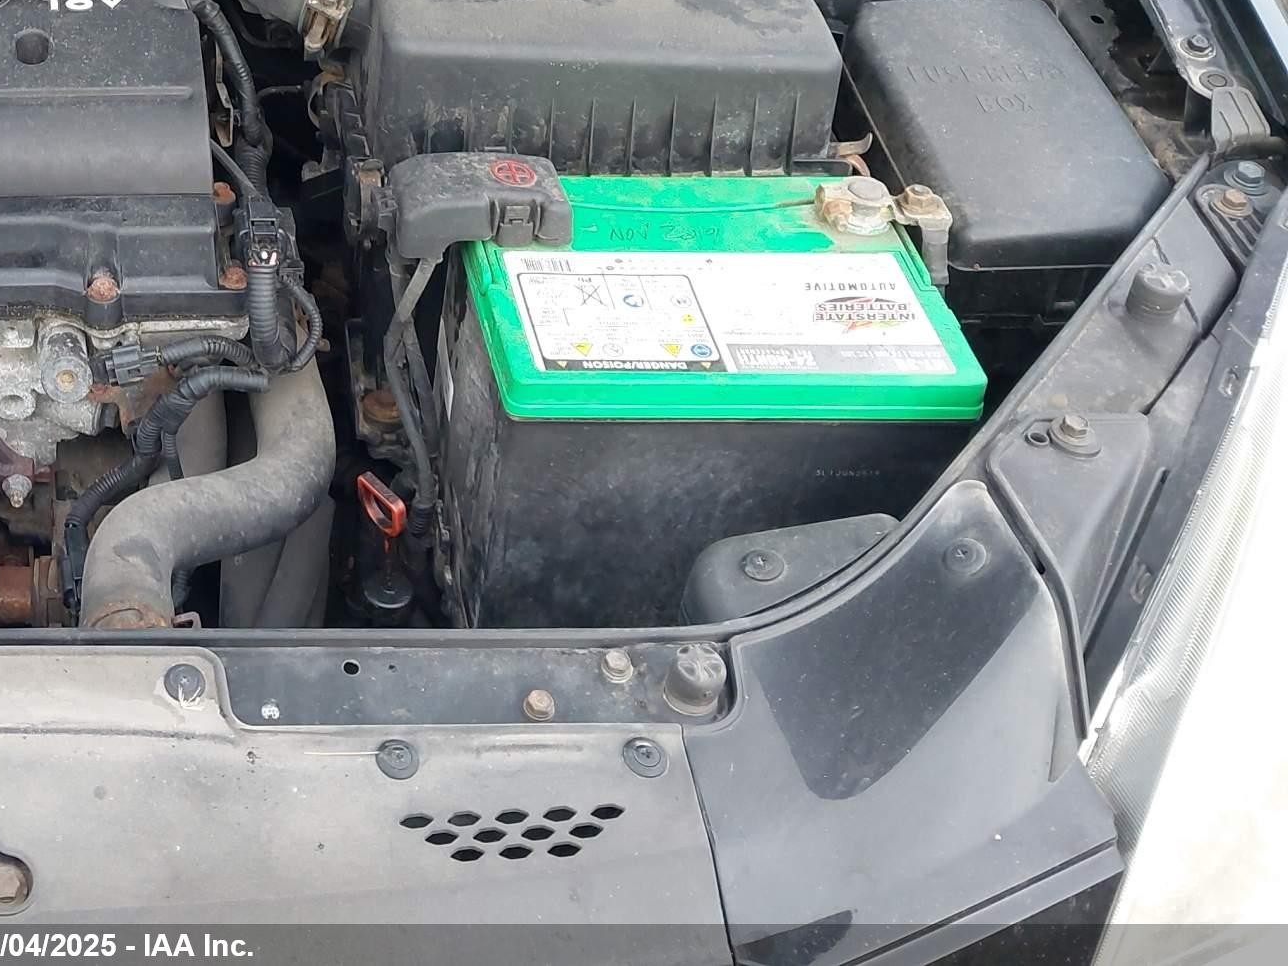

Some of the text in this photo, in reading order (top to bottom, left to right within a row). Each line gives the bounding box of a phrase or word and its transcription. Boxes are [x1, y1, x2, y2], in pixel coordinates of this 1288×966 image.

[804, 282, 897, 291] AUTOMOTIVE
[817, 303, 908, 311] BATTERIES
[815, 313, 916, 321] INTERSTATE
[582, 360, 688, 370] DANGER/POISON
